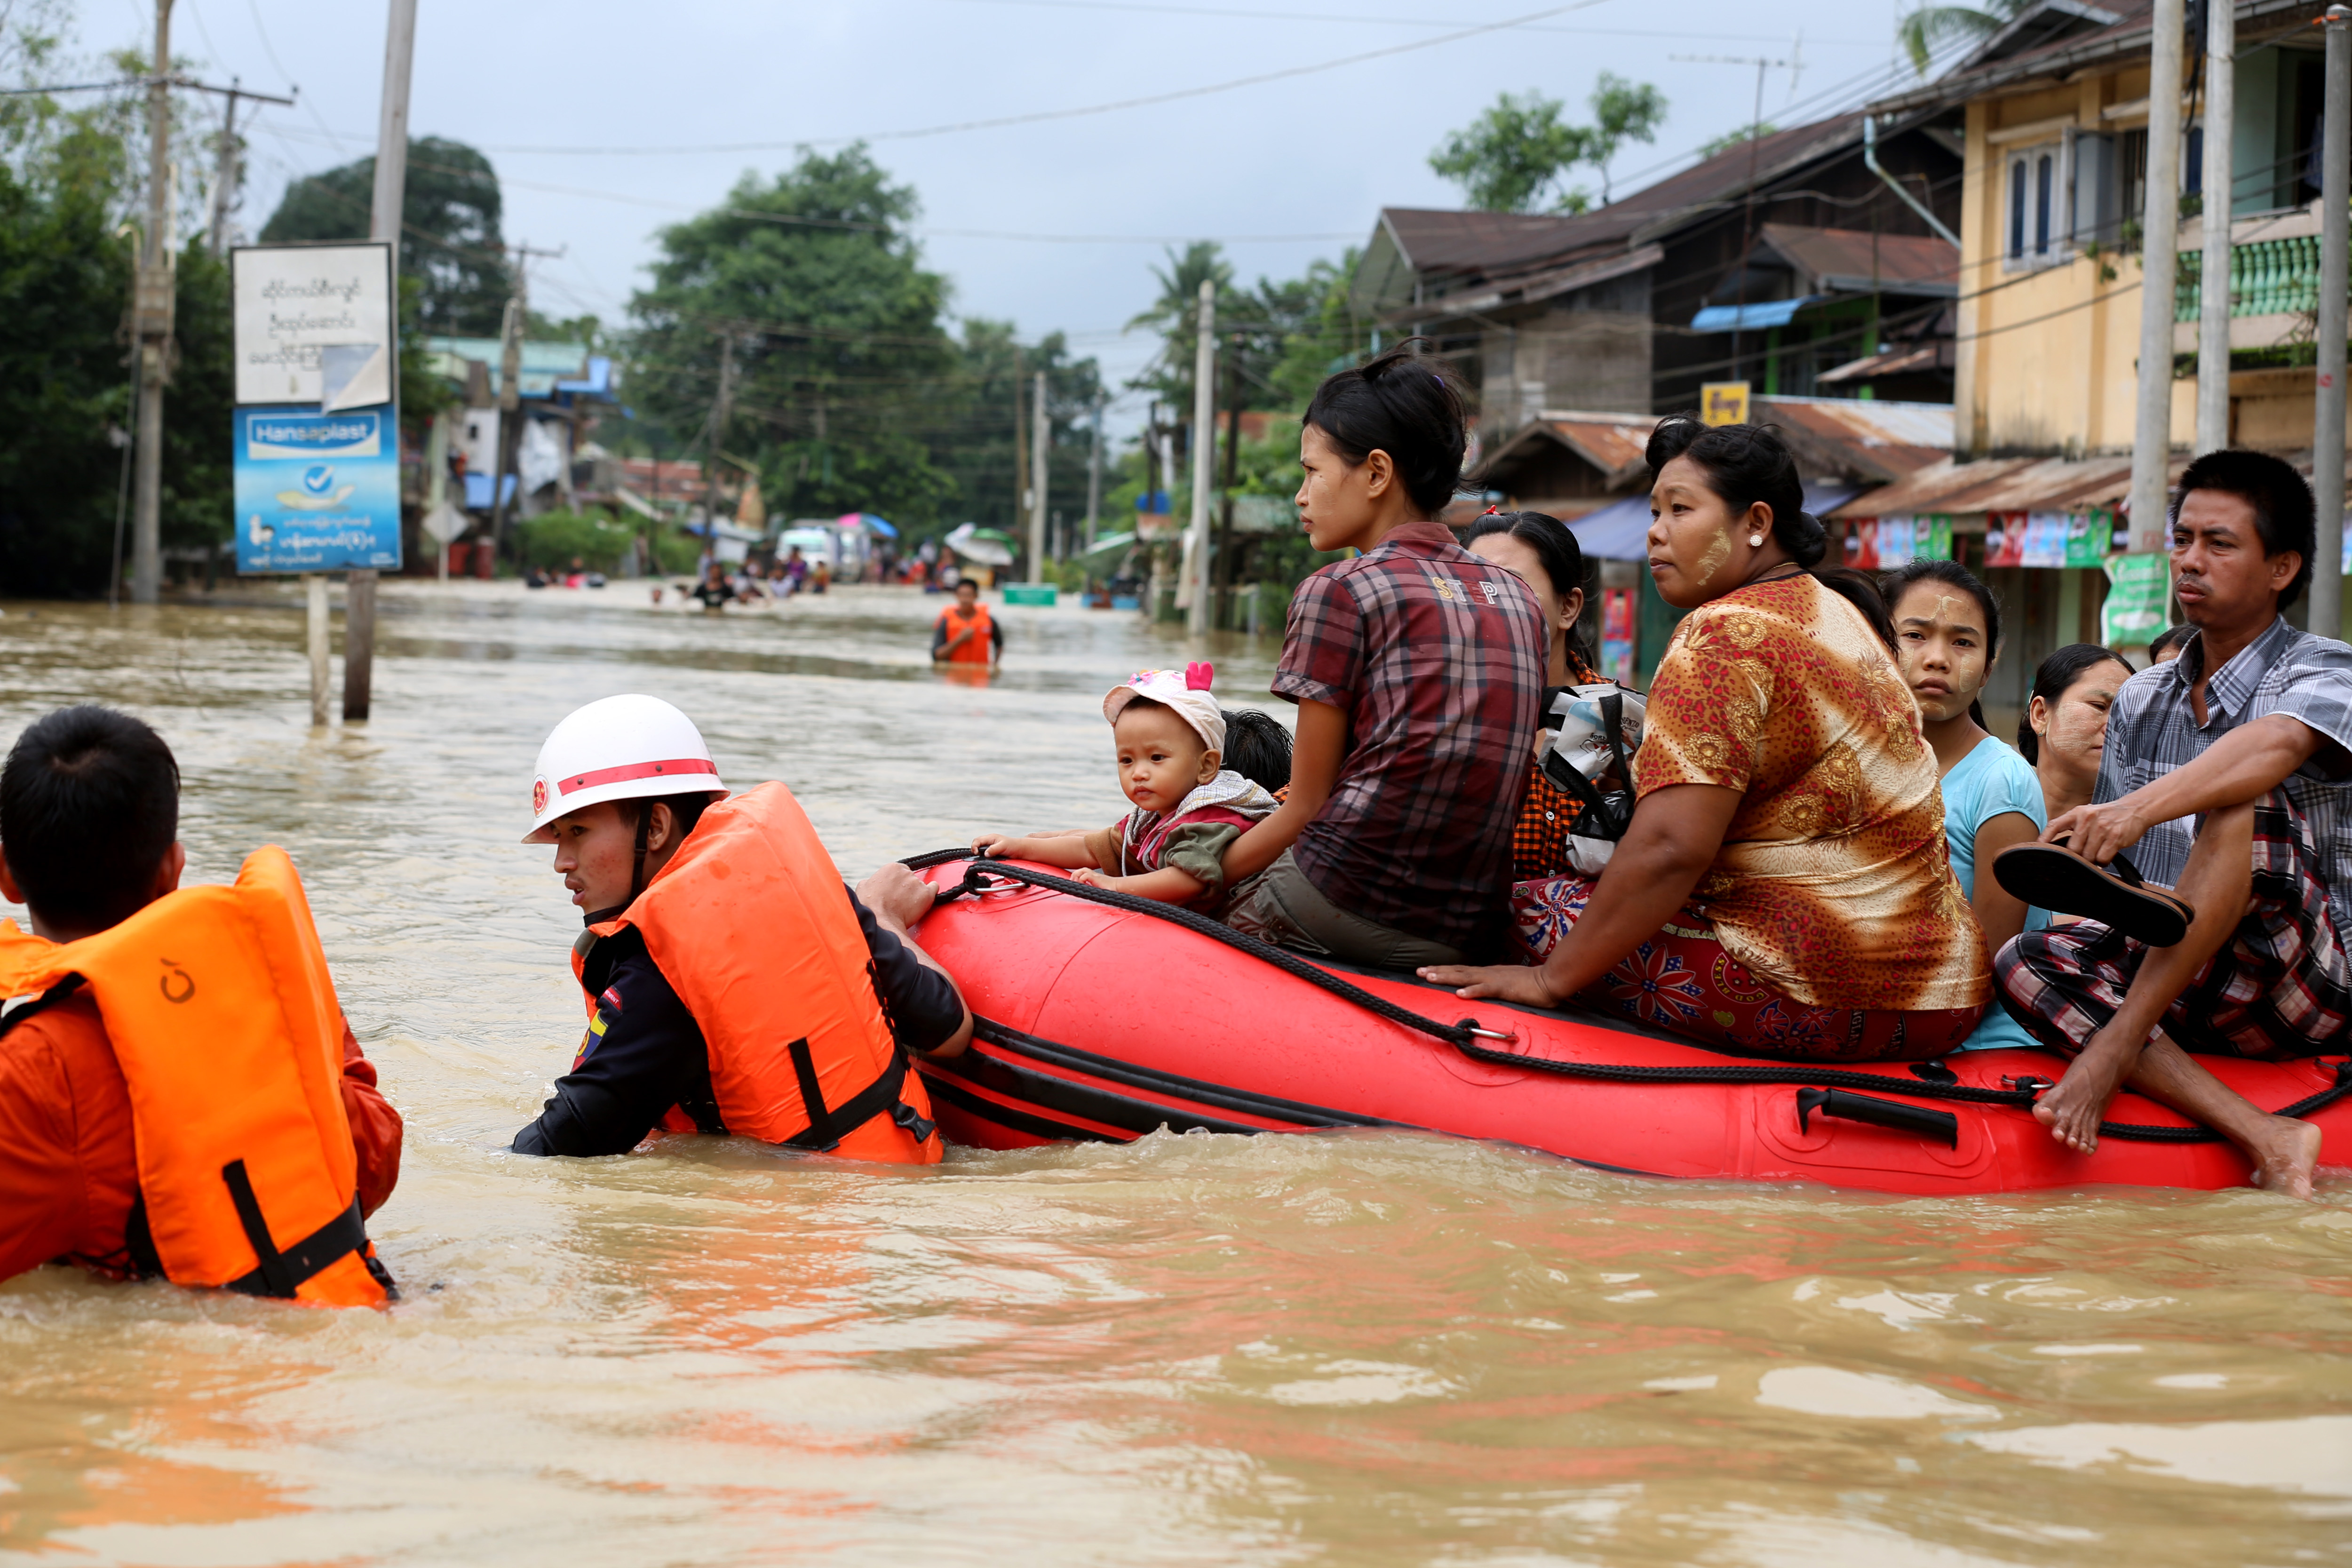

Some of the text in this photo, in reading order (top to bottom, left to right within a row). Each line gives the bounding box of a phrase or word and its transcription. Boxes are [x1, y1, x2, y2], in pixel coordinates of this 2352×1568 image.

[255, 422, 368, 444] Hansaplast
[1432, 577, 1498, 605] STEP
[1714, 958, 1764, 1002] GOD BLESS
